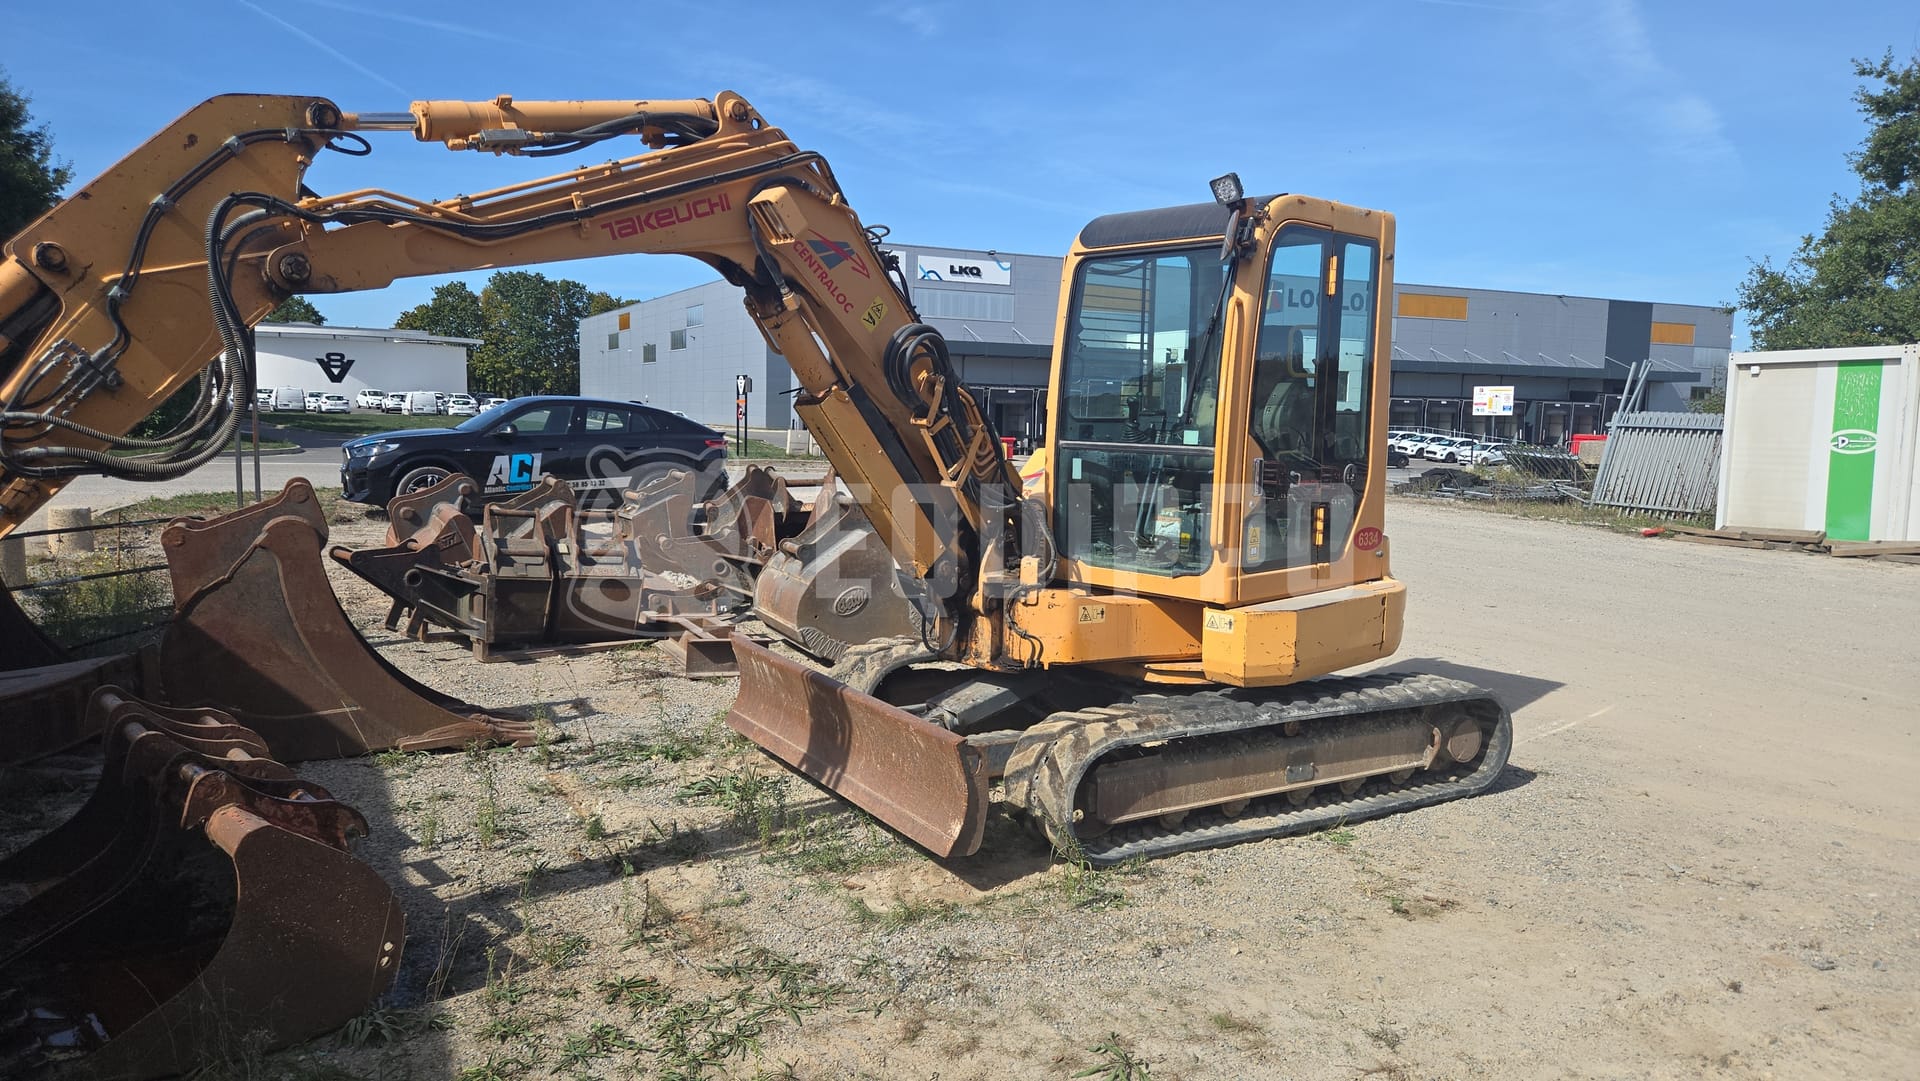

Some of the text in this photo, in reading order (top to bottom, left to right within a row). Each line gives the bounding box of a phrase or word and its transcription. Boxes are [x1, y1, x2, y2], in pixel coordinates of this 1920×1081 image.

[793, 240, 854, 314] CENTRALOC
[949, 264, 983, 279] LKQ
[483, 452, 551, 487] ACL
[1358, 530, 1380, 547] 6334
